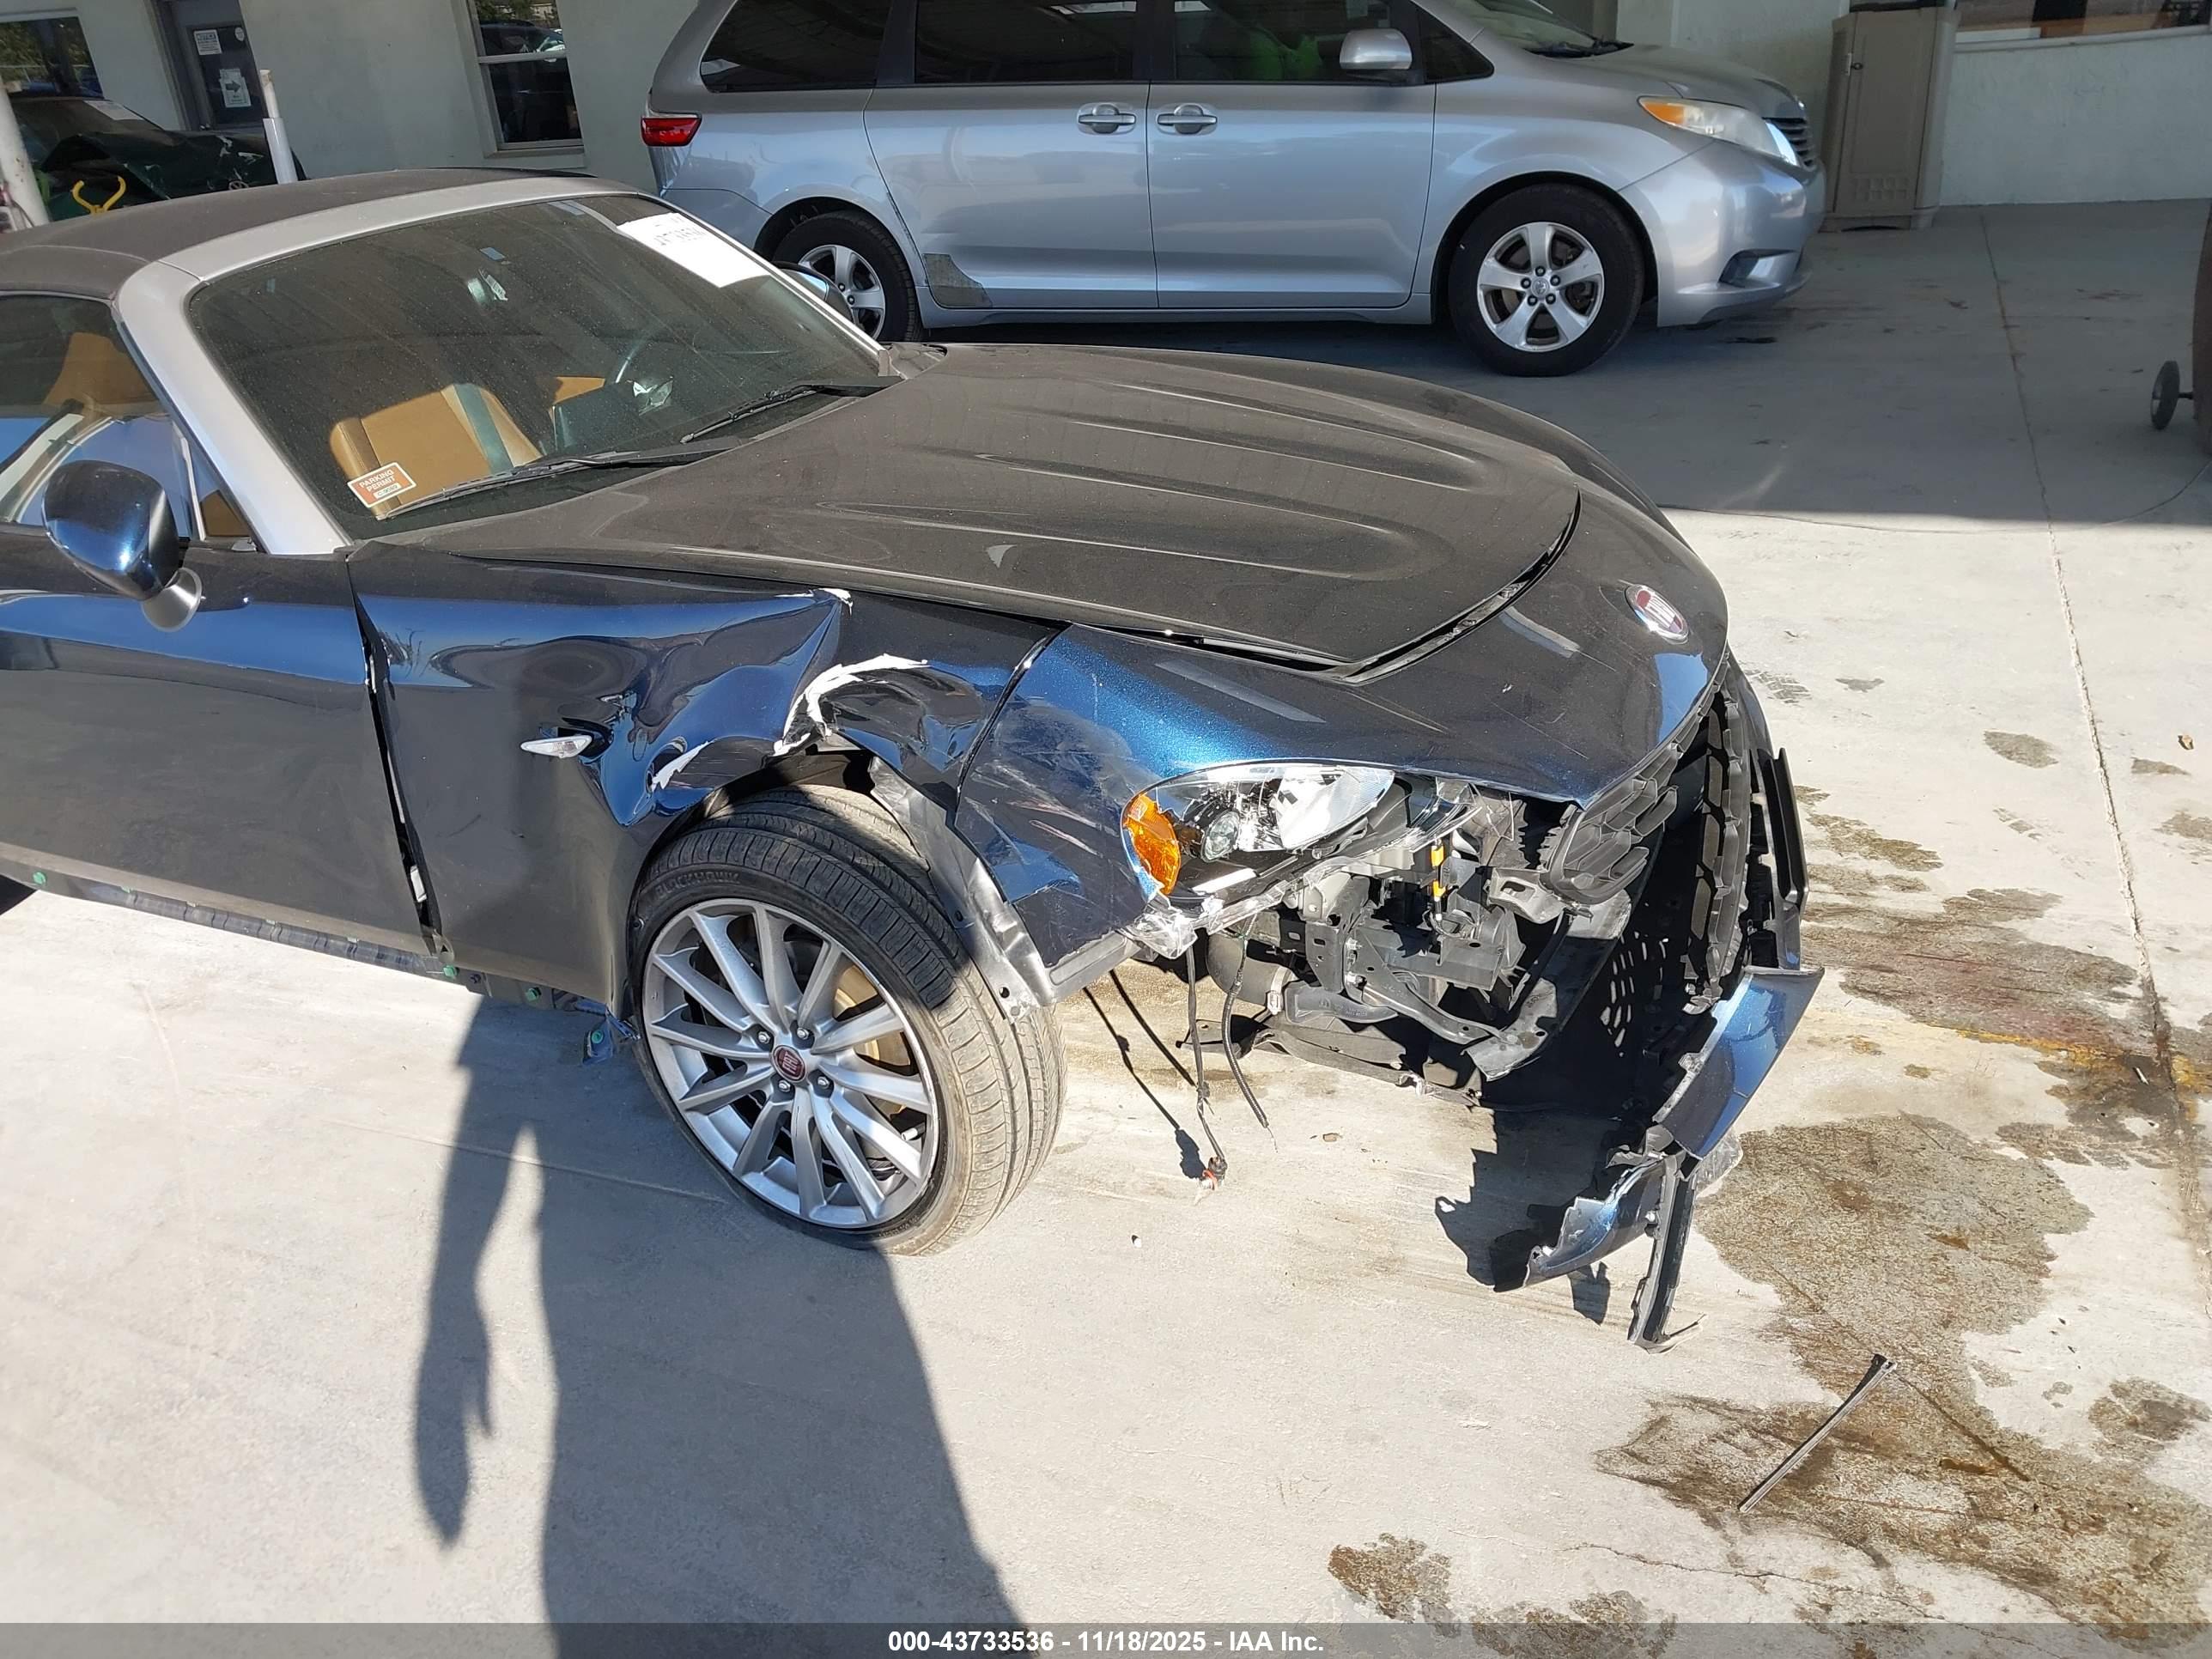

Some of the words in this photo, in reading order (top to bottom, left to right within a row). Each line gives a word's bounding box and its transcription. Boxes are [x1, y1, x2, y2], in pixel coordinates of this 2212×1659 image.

[359, 469, 395, 489] PARKING
[366, 476, 396, 492] PERMIT
[781, 1050, 799, 1075] FIAT
